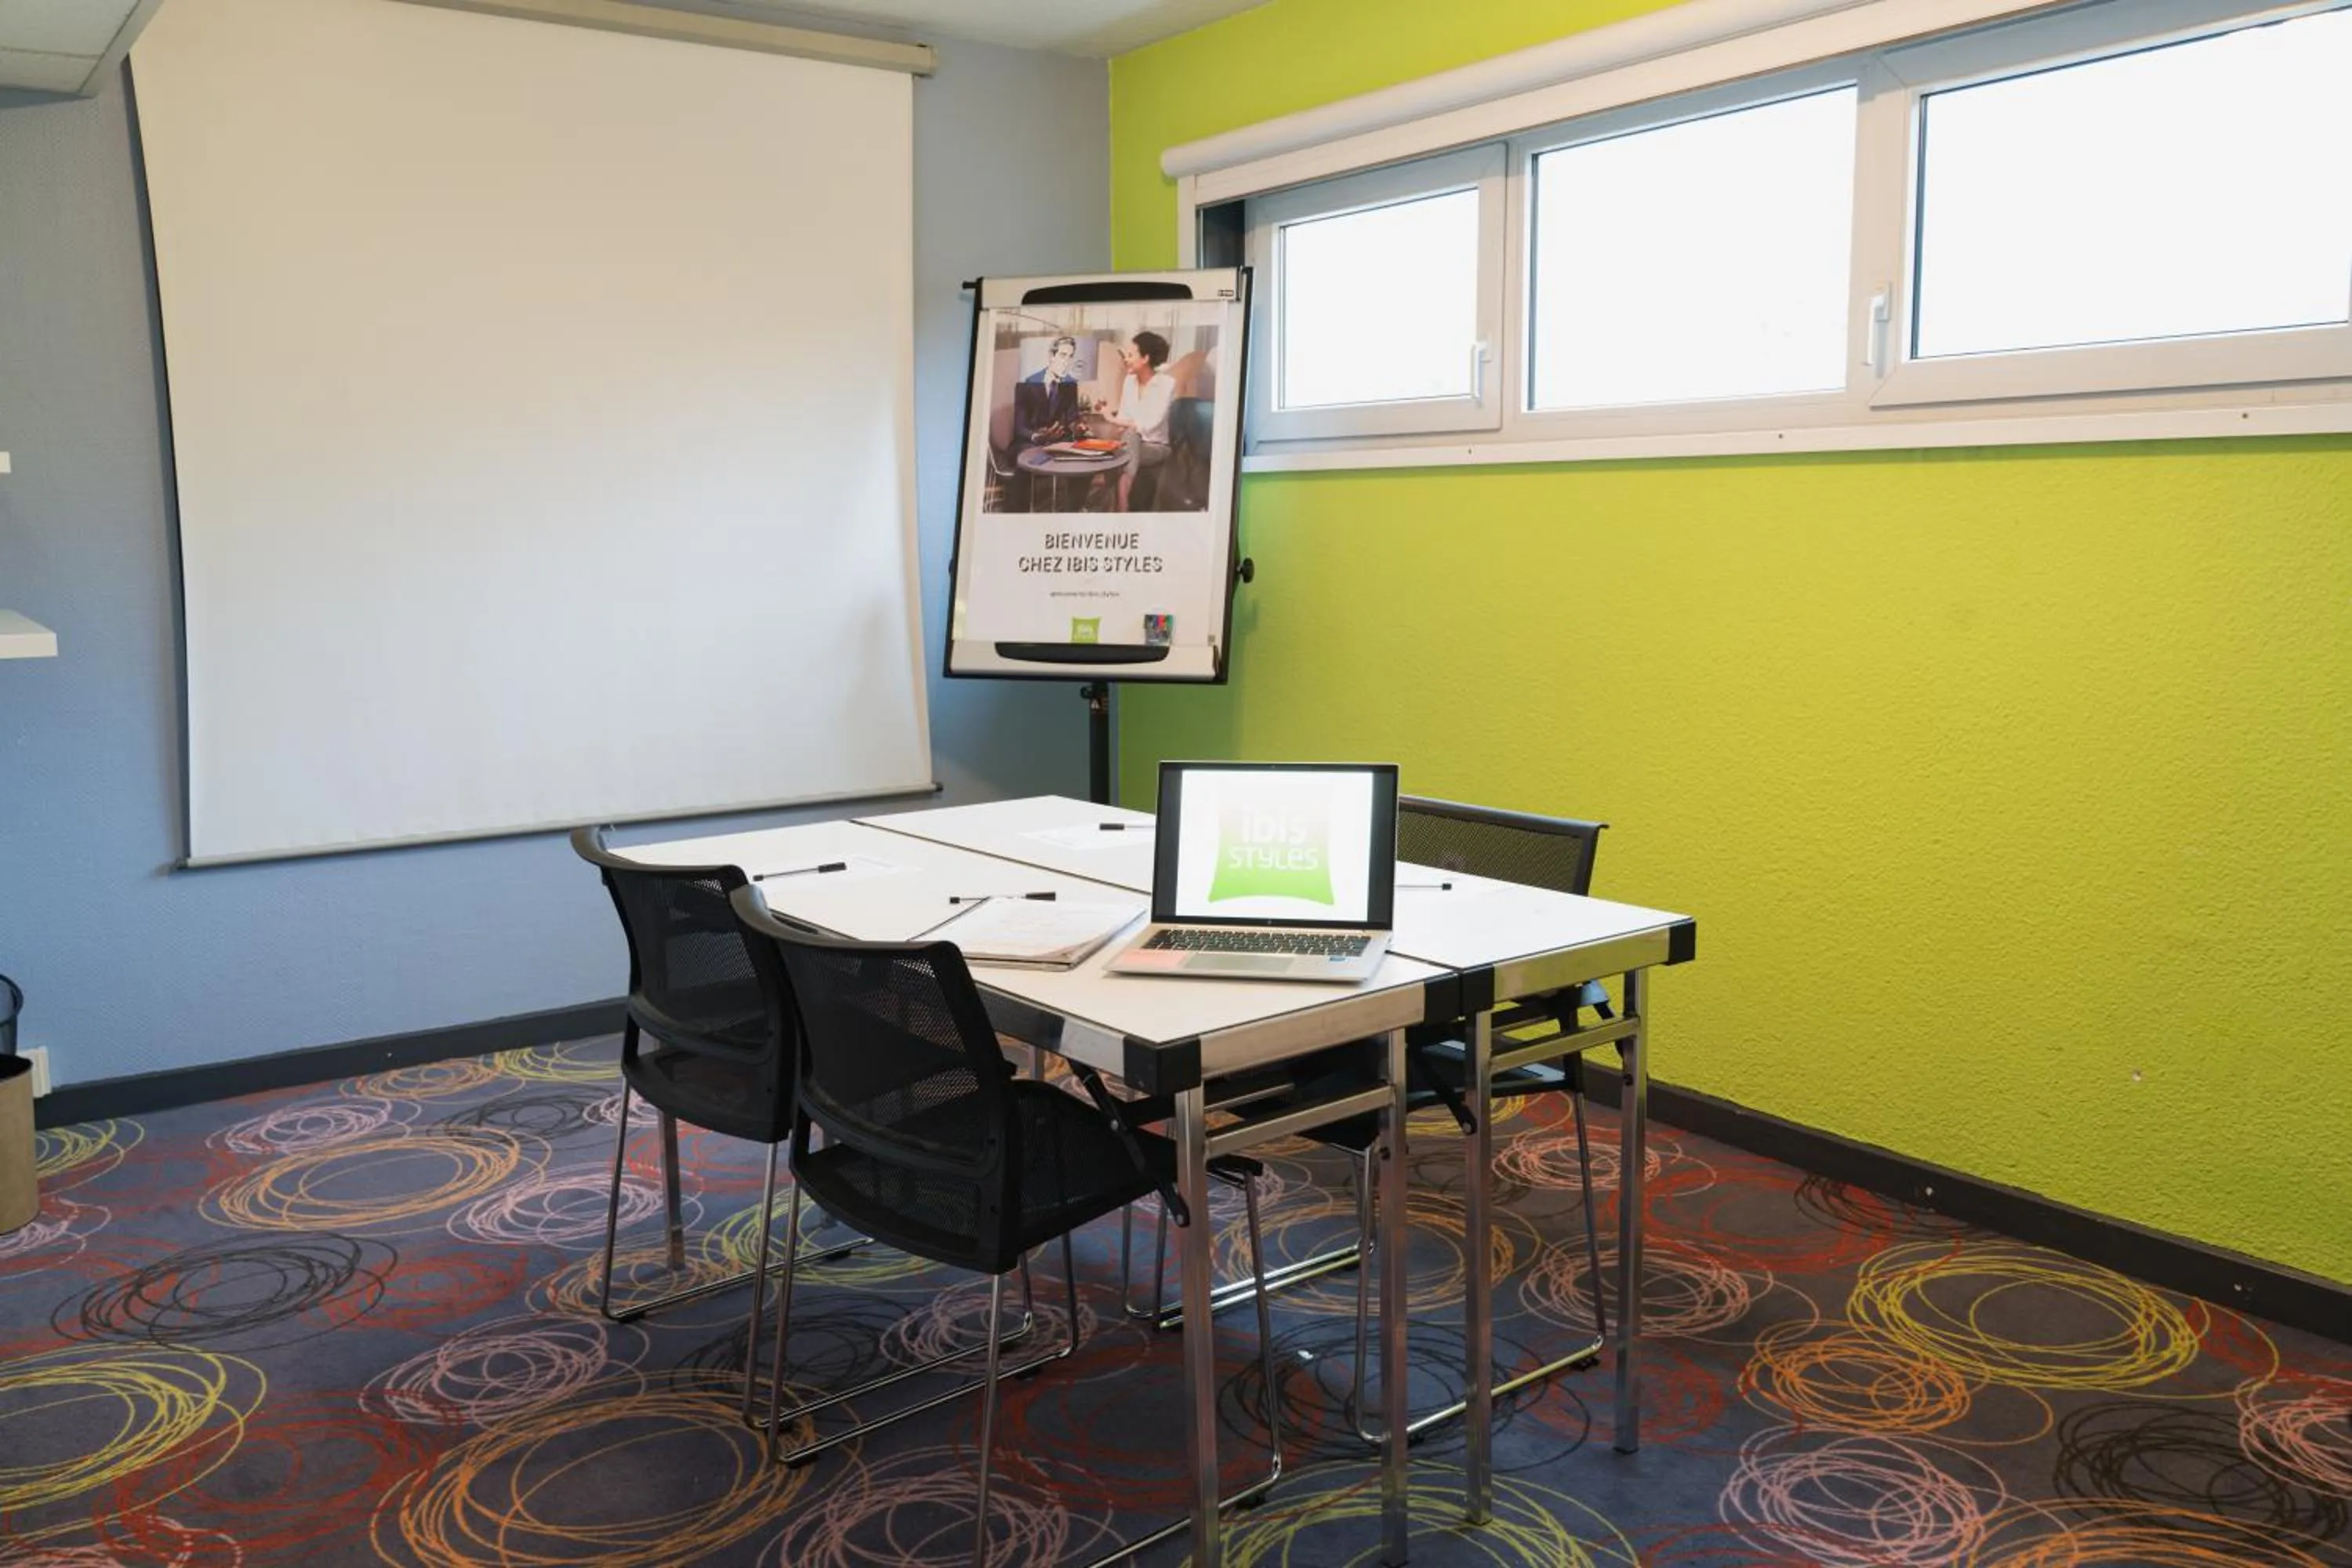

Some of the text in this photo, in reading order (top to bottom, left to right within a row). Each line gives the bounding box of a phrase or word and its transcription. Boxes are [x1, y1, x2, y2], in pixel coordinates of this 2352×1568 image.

[1044, 532, 1140, 550] BIENVENUE
[1018, 556, 1163, 573] CHEZ IBIS STYLES
